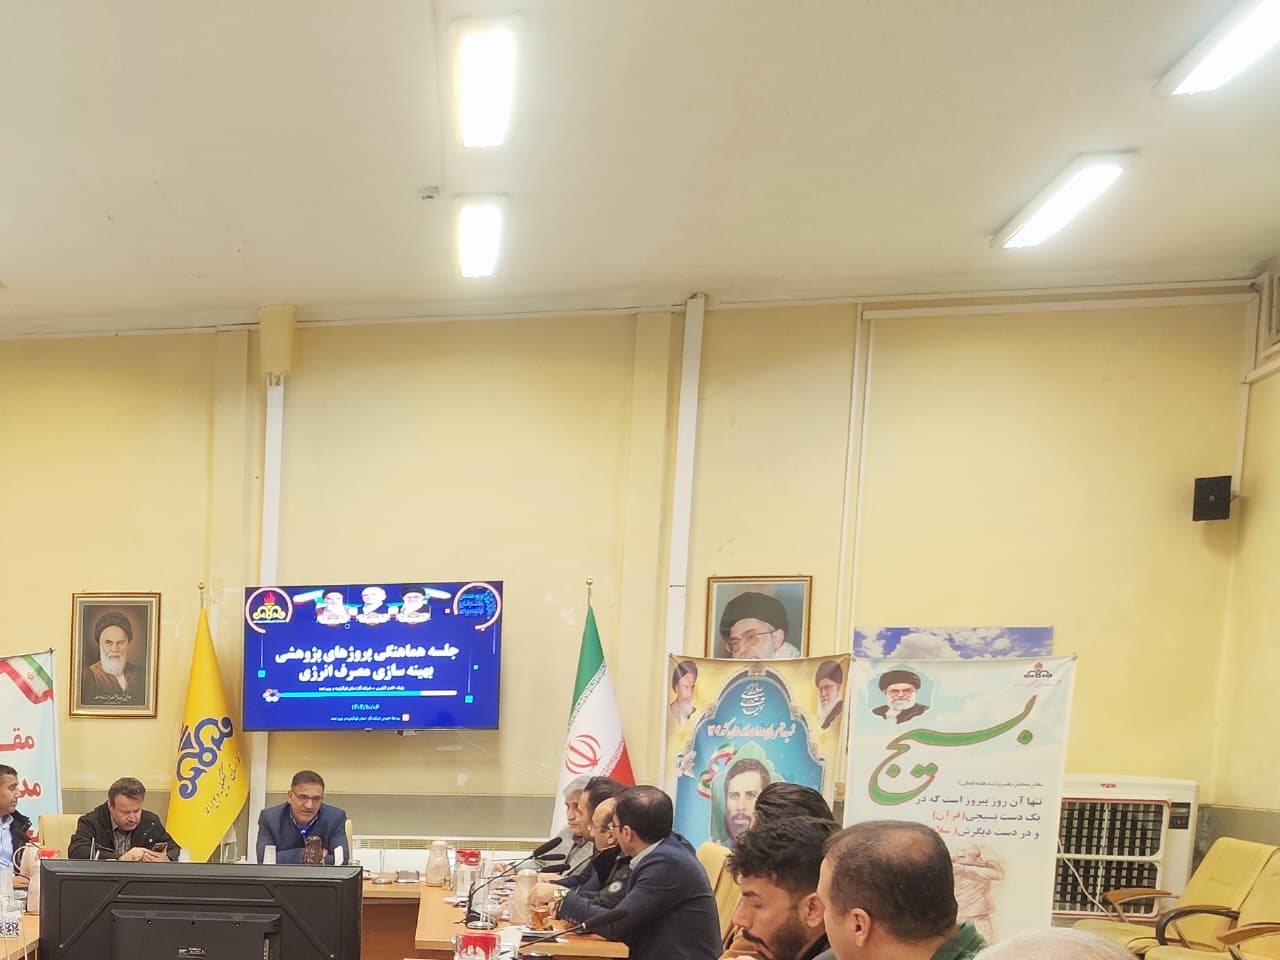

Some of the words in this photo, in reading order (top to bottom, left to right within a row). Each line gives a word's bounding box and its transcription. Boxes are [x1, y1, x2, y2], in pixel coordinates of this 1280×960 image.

[275, 646, 323, 664] پژوهشی
[373, 643, 426, 662] هماهنگی
[427, 643, 460, 661] جلسه
[298, 664, 333, 682] انرژی
[334, 664, 371, 682] مصرف
[373, 664, 406, 681] سازی
[406, 663, 435, 680] بهینه
[868, 694, 1038, 806] بسیج
[915, 796, 927, 805] در
[929, 794, 941, 803] که
[942, 795, 963, 803] است
[965, 796, 989, 807] پیروز
[990, 797, 1008, 808] روز
[1009, 796, 1025, 807] آن
[1026, 796, 1043, 807] تنها
[999, 813, 1023, 822] دست
[1025, 813, 1041, 824] یک
[993, 828, 1018, 837] دست
[1019, 829, 1032, 839] در
[1034, 831, 1040, 839] و
